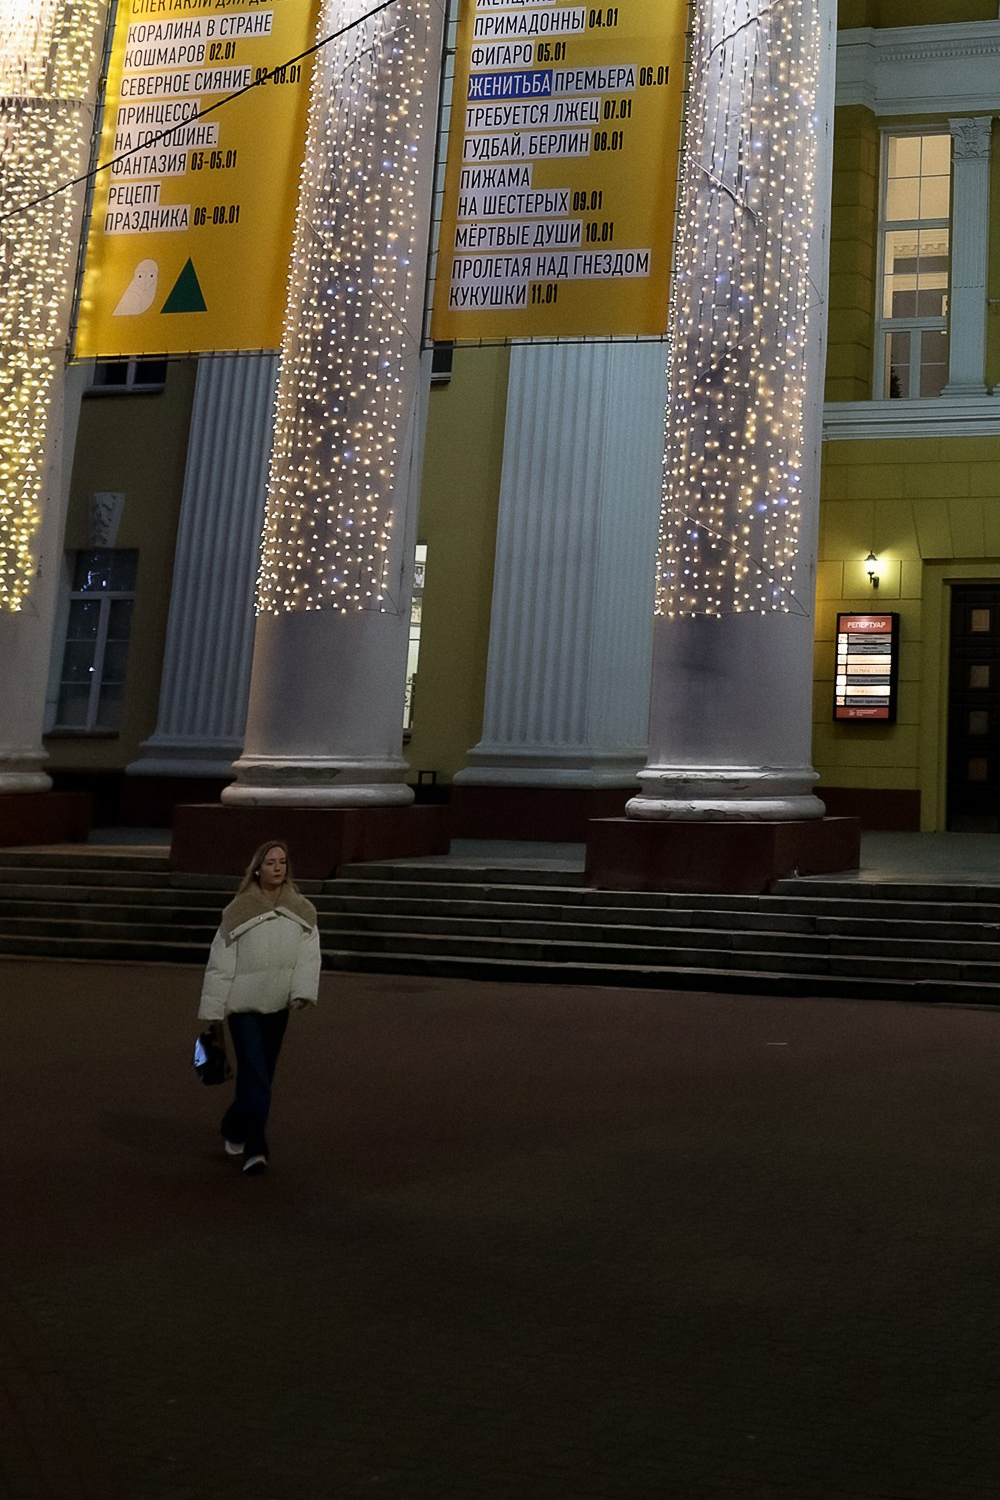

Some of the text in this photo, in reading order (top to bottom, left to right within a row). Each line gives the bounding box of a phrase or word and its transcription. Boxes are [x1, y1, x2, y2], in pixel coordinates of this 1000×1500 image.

[128, 14, 272, 44] КОРАЛИНА В СТРАНЕ
[474, 8, 618, 37] ПРИМАДОННЫ 04.01
[124, 41, 236, 68] КОШМАРОВ 02.01
[472, 42, 566, 65] ФИГАРО 05.01
[120, 73, 189, 97] СЕВЕРНОЕ
[194, 69, 251, 91] СИЯНИЕ
[468, 66, 669, 97] ЖЕНИТЬБА ПРЕМЬЕРА 06.01
[117, 102, 199, 126] ПРИНЦЕССА
[466, 99, 632, 128] ТРЕБУЕТСЯ ЛЖЕЦ 07.01
[114, 125, 217, 150] НА ГОРОШИНЕ.
[464, 131, 623, 160] ГУДБАЙ, БЕРЛИН 08.01
[111, 150, 237, 176] ФАНТАЗИЯ 03-05.01
[461, 167, 530, 189] ПИЖАМА
[108, 185, 161, 206] РЕЦЕПТ
[458, 191, 602, 216] НА ШЕСТЕРЫХ 09.01
[105, 205, 240, 232] ПРАЗДНИКА 06-08.01
[455, 222, 614, 248] МЁРТВЫЕ ДУШИ 10.01
[452, 252, 649, 279] ПРОЛЕТАЯ НАД ГНЕЗДОМ
[449, 284, 558, 306] КУКУШКИ 11.01
